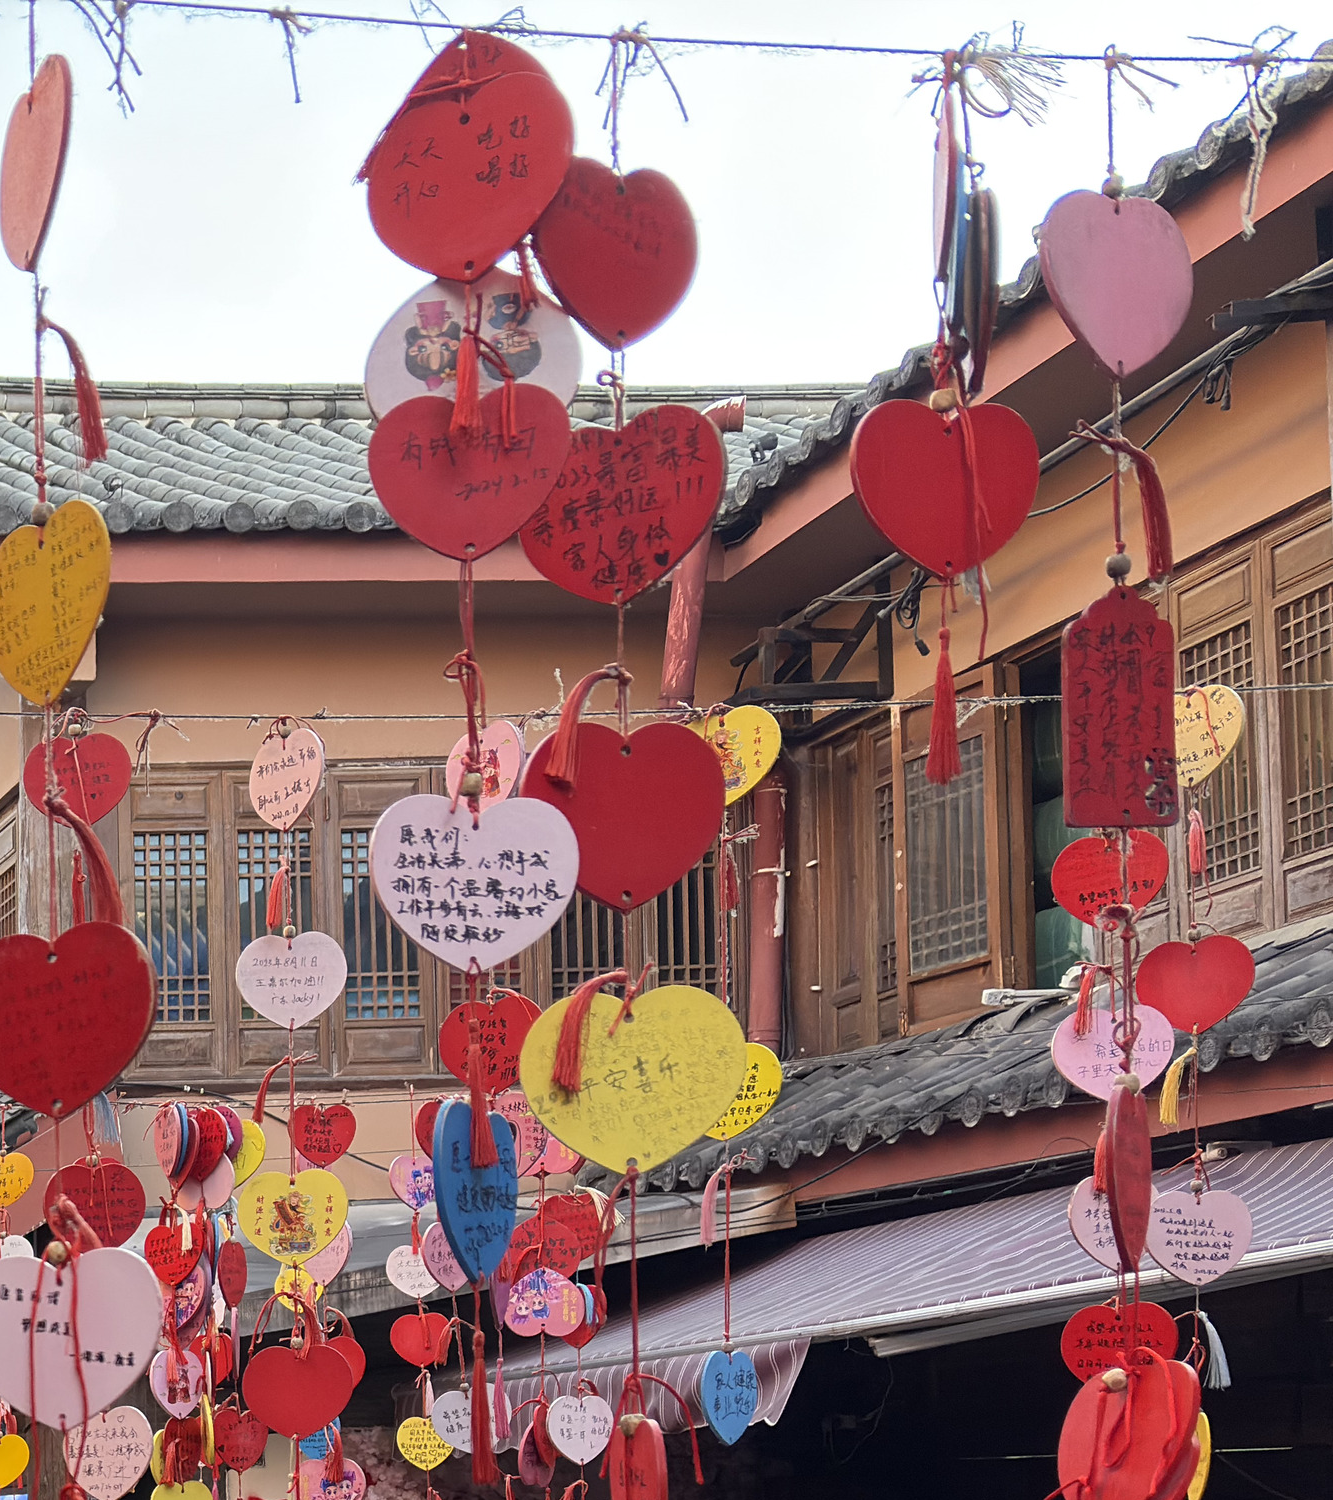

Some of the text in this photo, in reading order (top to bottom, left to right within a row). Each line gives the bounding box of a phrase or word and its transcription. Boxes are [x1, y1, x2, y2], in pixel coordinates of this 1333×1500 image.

[752, 724, 764, 769] 吉祥如意
[252, 955, 318, 970] 2023年8月11日
[255, 1194, 266, 1236] 财源广进
[324, 1193, 334, 1237] 吉祥如意
